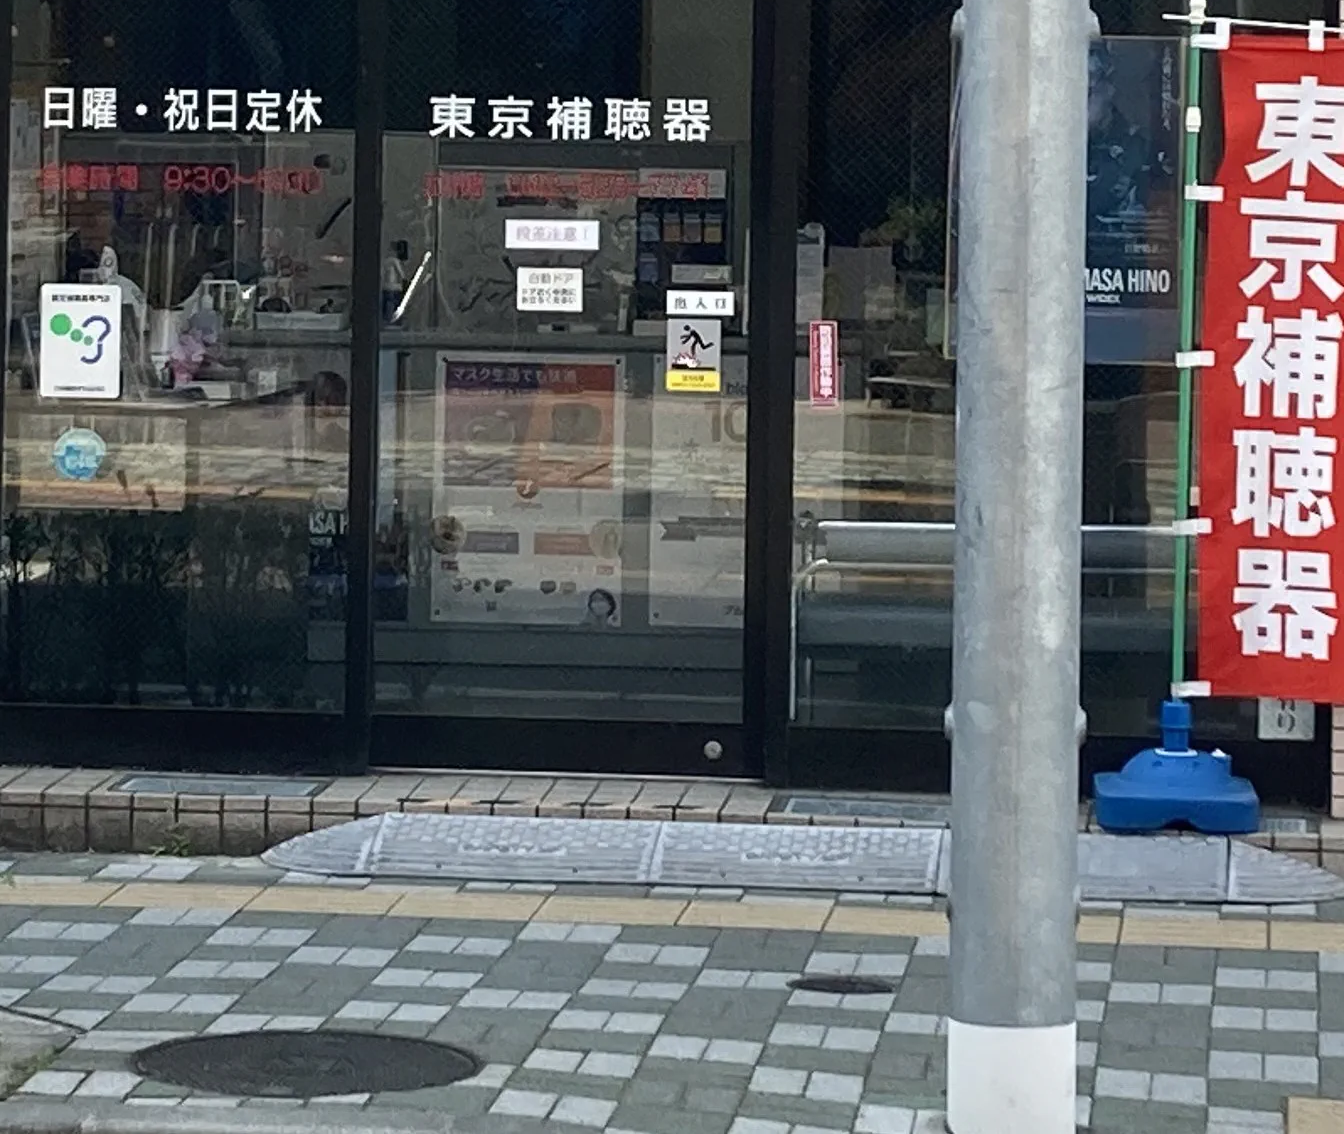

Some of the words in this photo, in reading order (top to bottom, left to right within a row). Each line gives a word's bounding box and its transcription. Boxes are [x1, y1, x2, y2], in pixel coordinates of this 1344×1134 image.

[43, 87, 323, 132] 日曜・祝日定休
[429, 94, 712, 142] 東京補聴器
[1128, 268, 1171, 294] HINO
